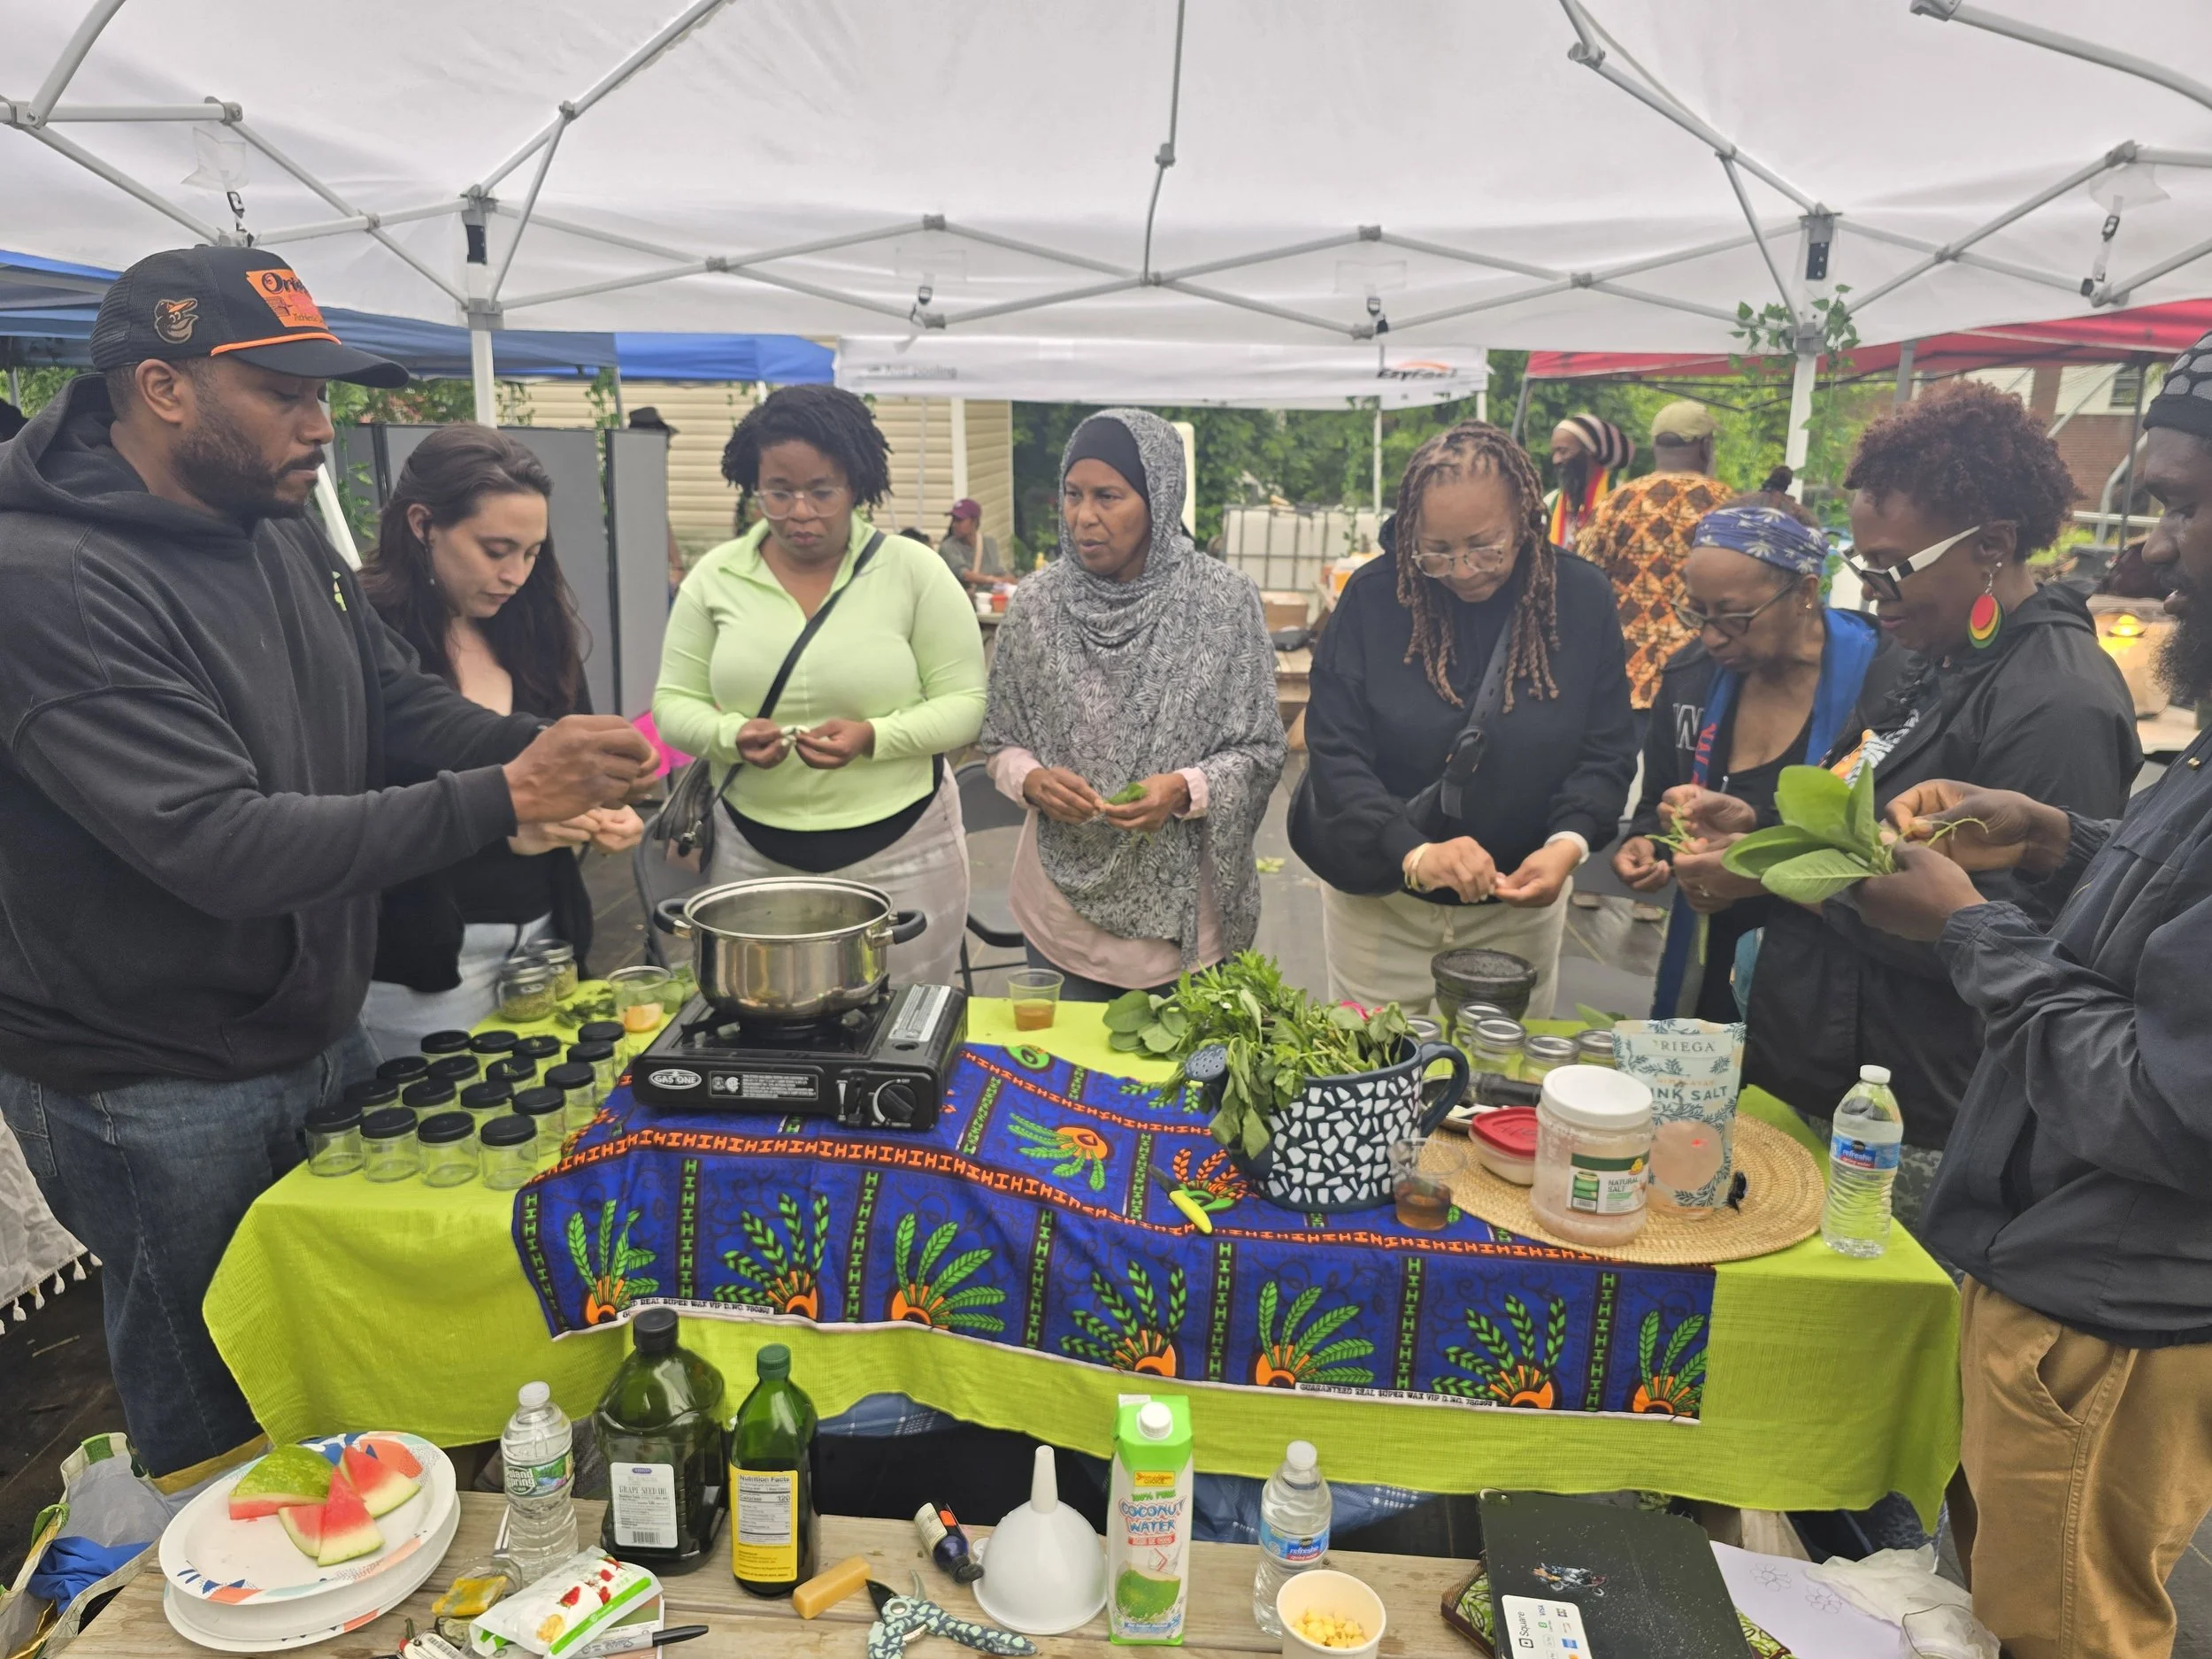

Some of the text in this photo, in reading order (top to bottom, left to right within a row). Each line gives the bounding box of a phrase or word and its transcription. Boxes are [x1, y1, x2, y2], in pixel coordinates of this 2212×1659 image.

[677, 1076, 697, 1085] ONE
[1650, 1086, 1728, 1101] INK SALT
[1608, 1177, 1639, 1187] NATURAL
[740, 1474, 769, 1483] Nutrition
[1120, 1497, 1187, 1518] COCONUT
[1129, 1519, 1176, 1533] WATER
[1517, 1610, 1531, 1637] Square
